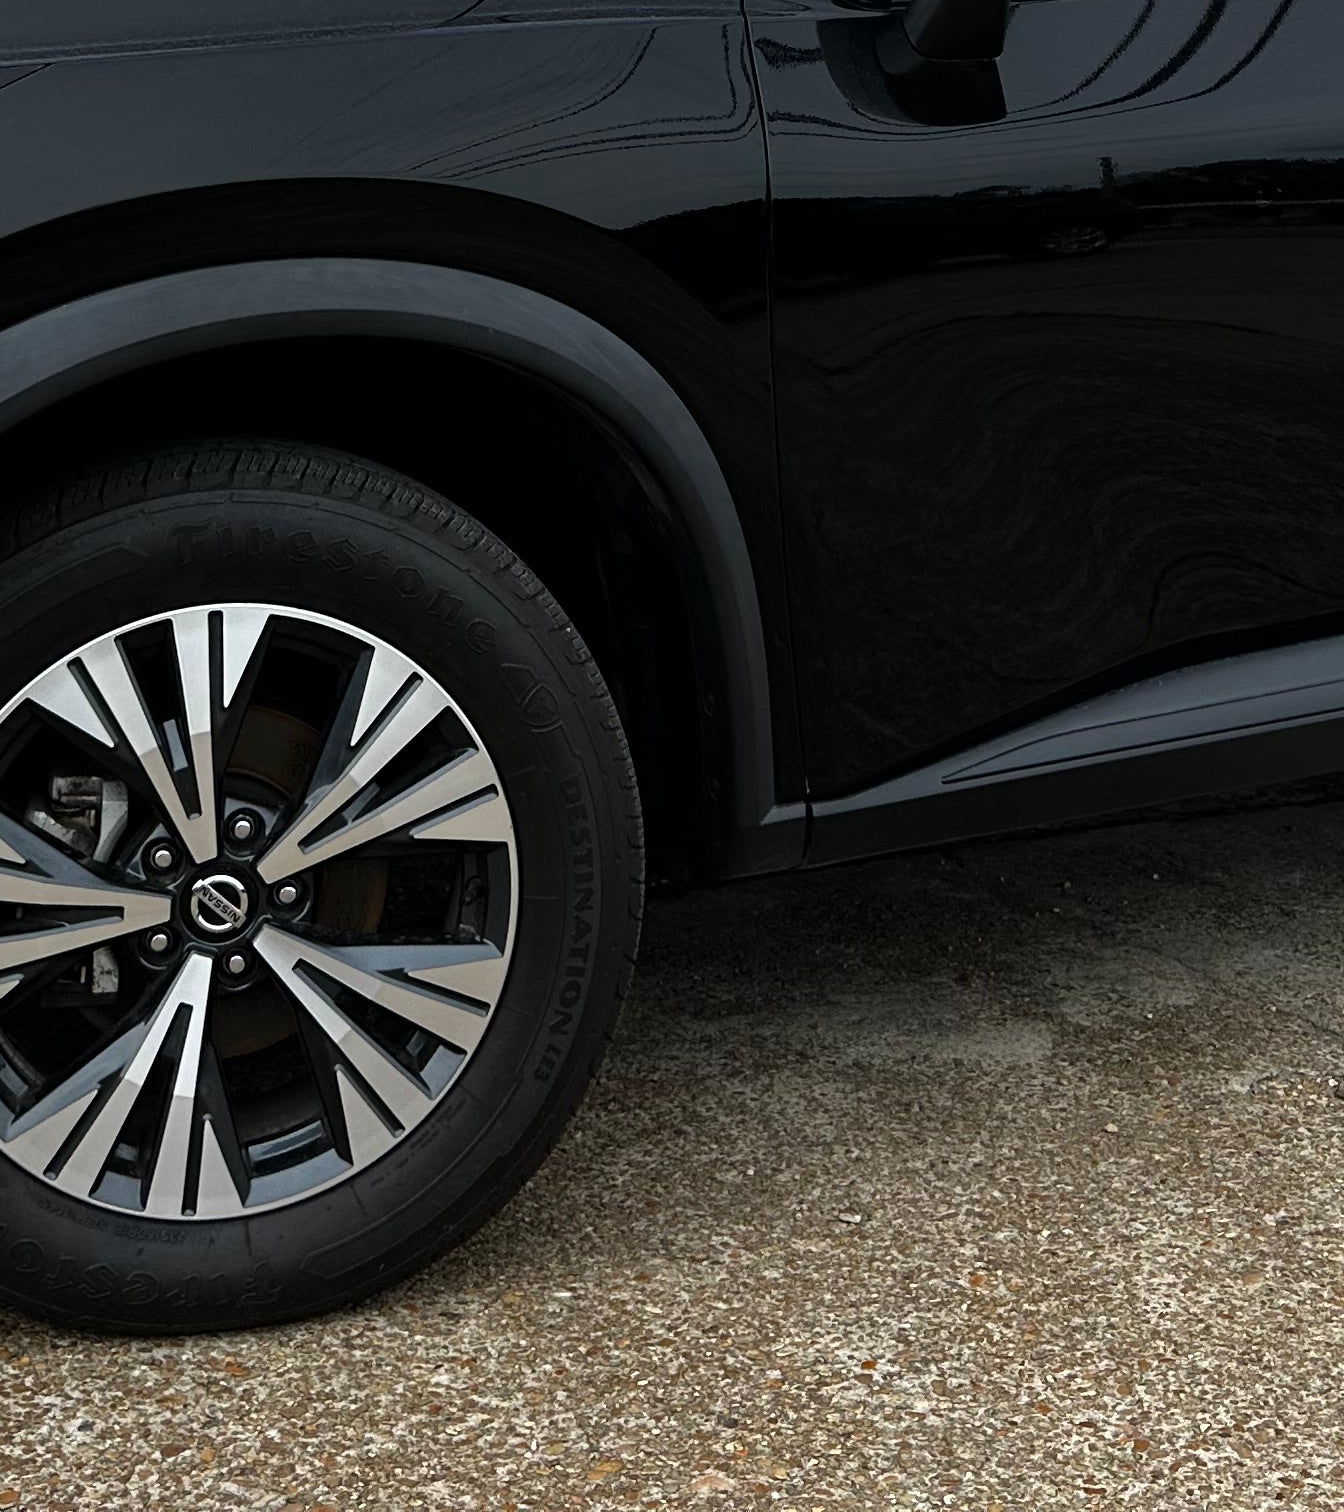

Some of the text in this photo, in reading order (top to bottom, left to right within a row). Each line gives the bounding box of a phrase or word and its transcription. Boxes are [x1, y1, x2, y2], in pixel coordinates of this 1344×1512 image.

[169, 521, 497, 656] Firestone
[201, 886, 240, 923] NISSAN
[550, 774, 594, 1036] DESTINATION
